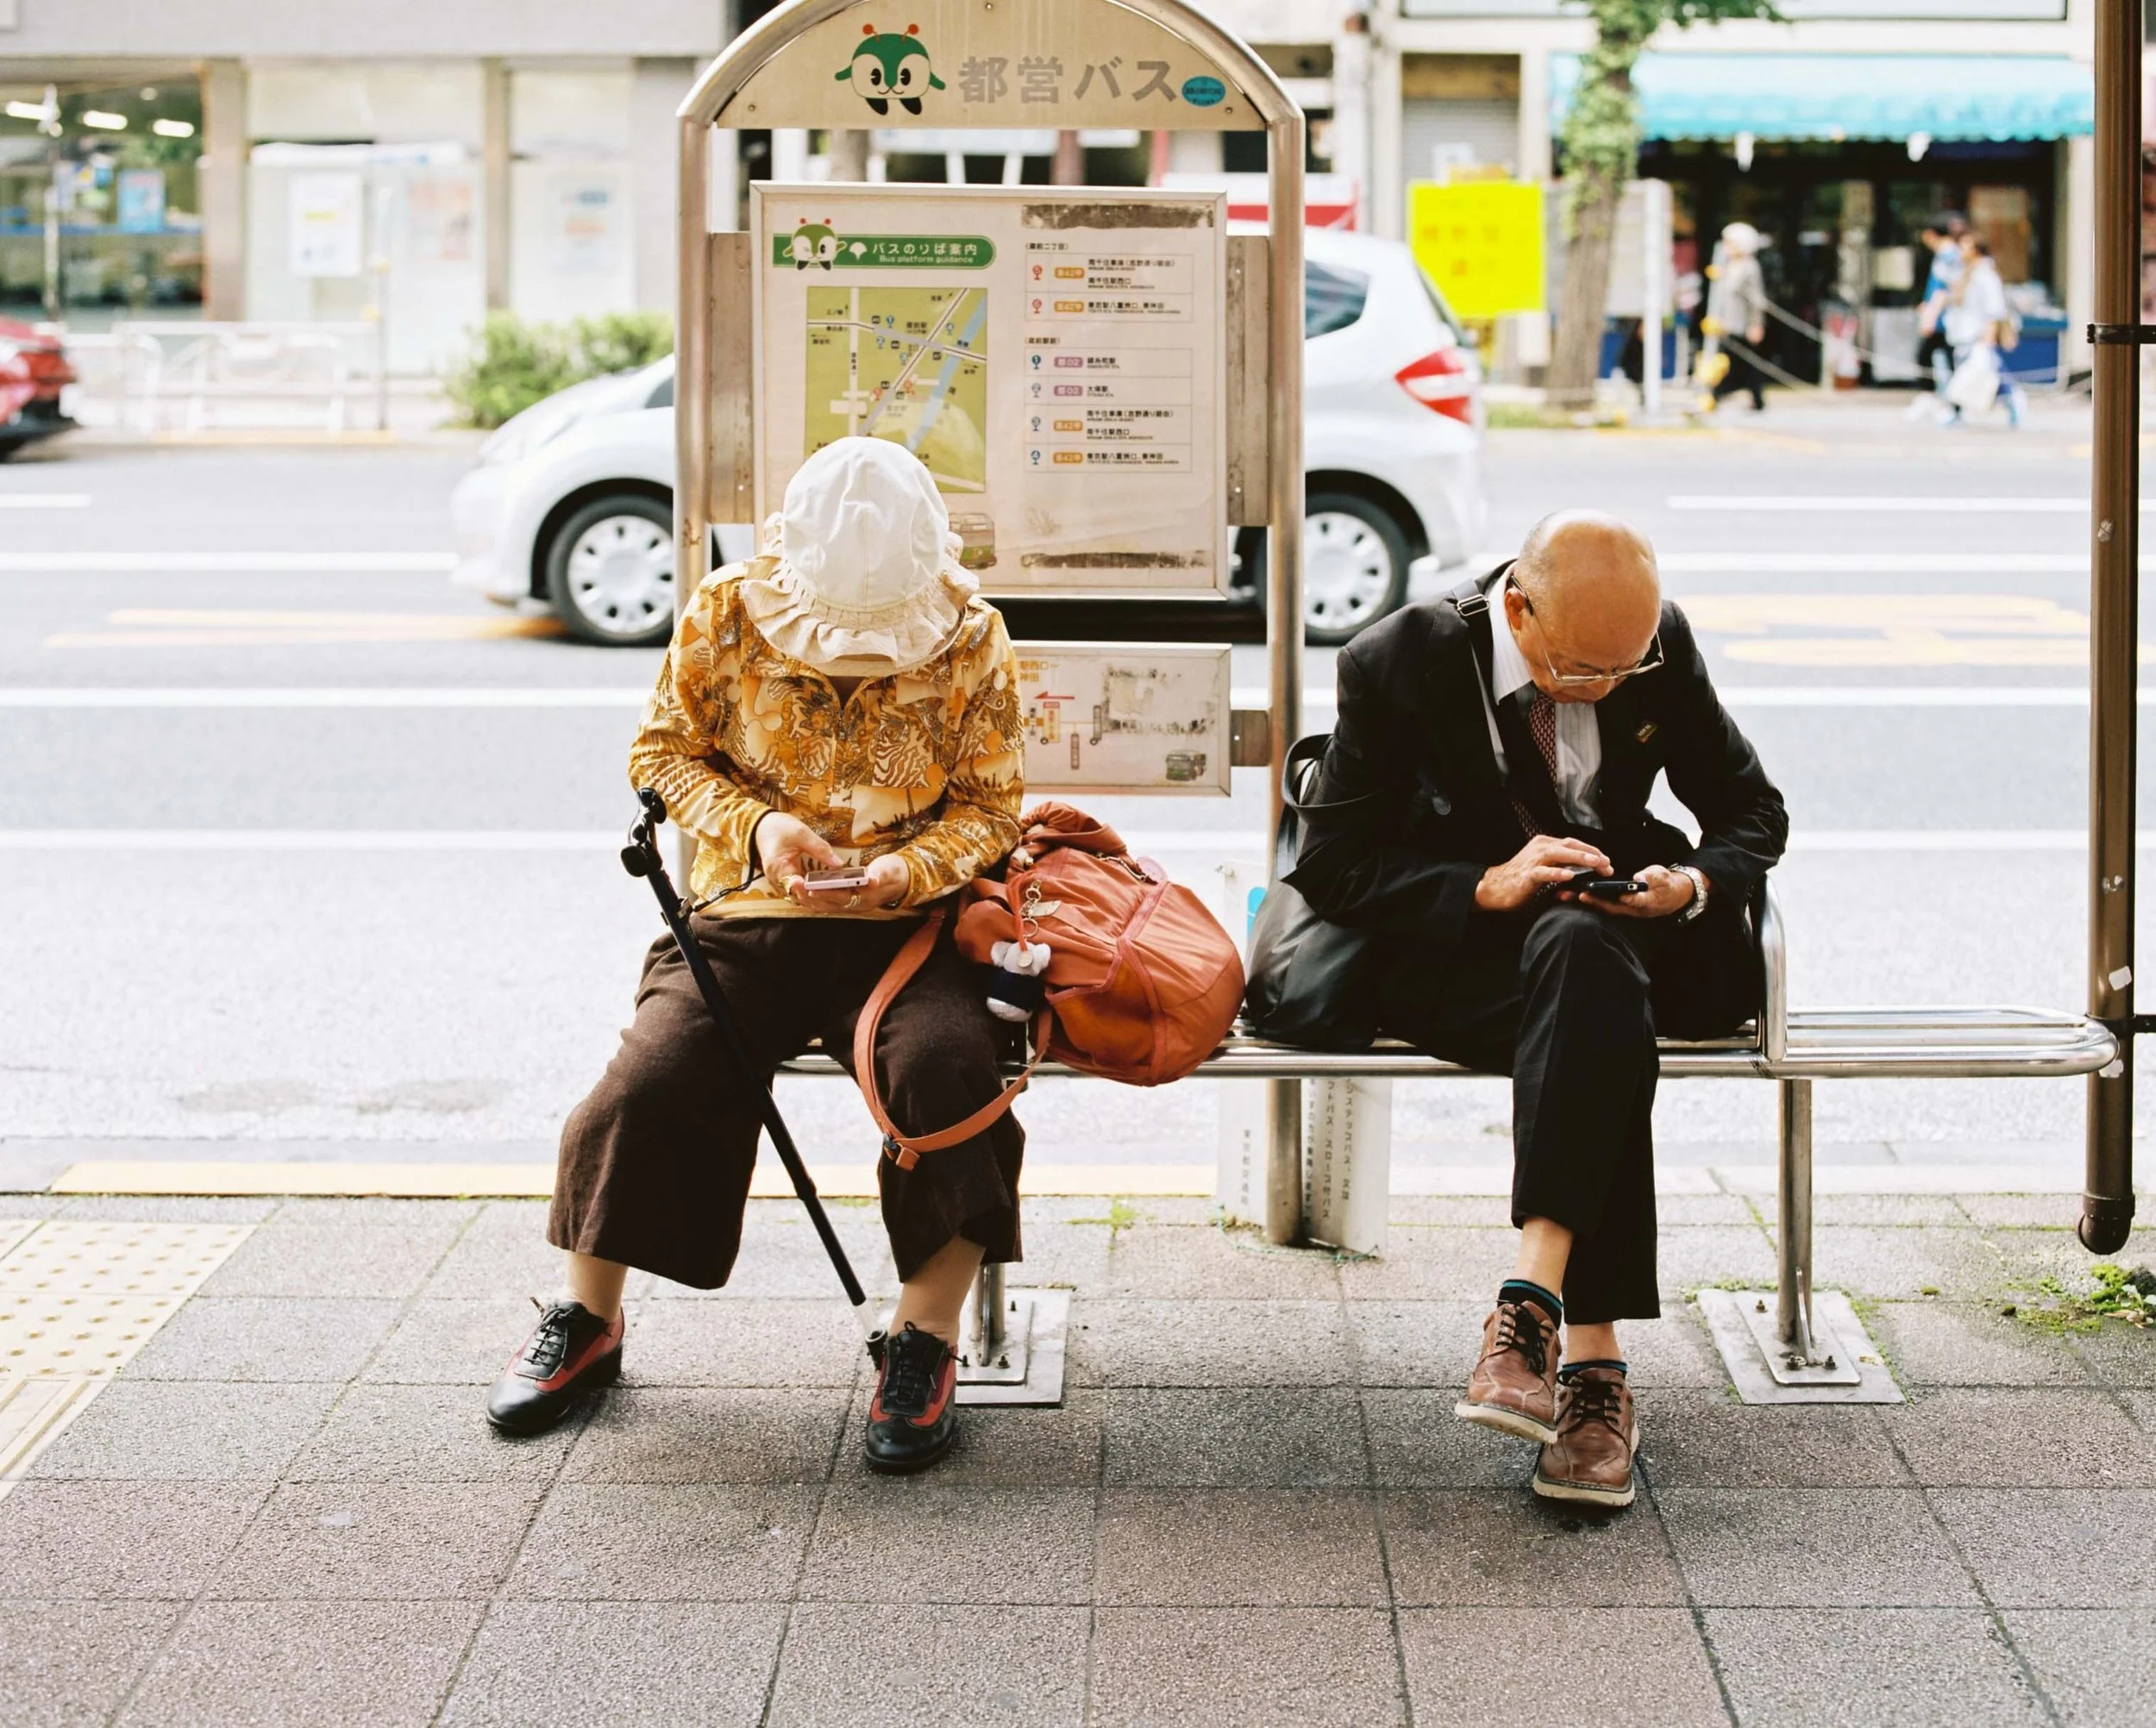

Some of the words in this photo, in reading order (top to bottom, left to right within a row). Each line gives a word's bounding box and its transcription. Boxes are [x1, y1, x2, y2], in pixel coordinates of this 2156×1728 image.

[959, 56, 1176, 104] 都営バス
[873, 242, 977, 255] バスのりば案内
[898, 255, 934, 265] platform
[936, 255, 974, 265] guidance
